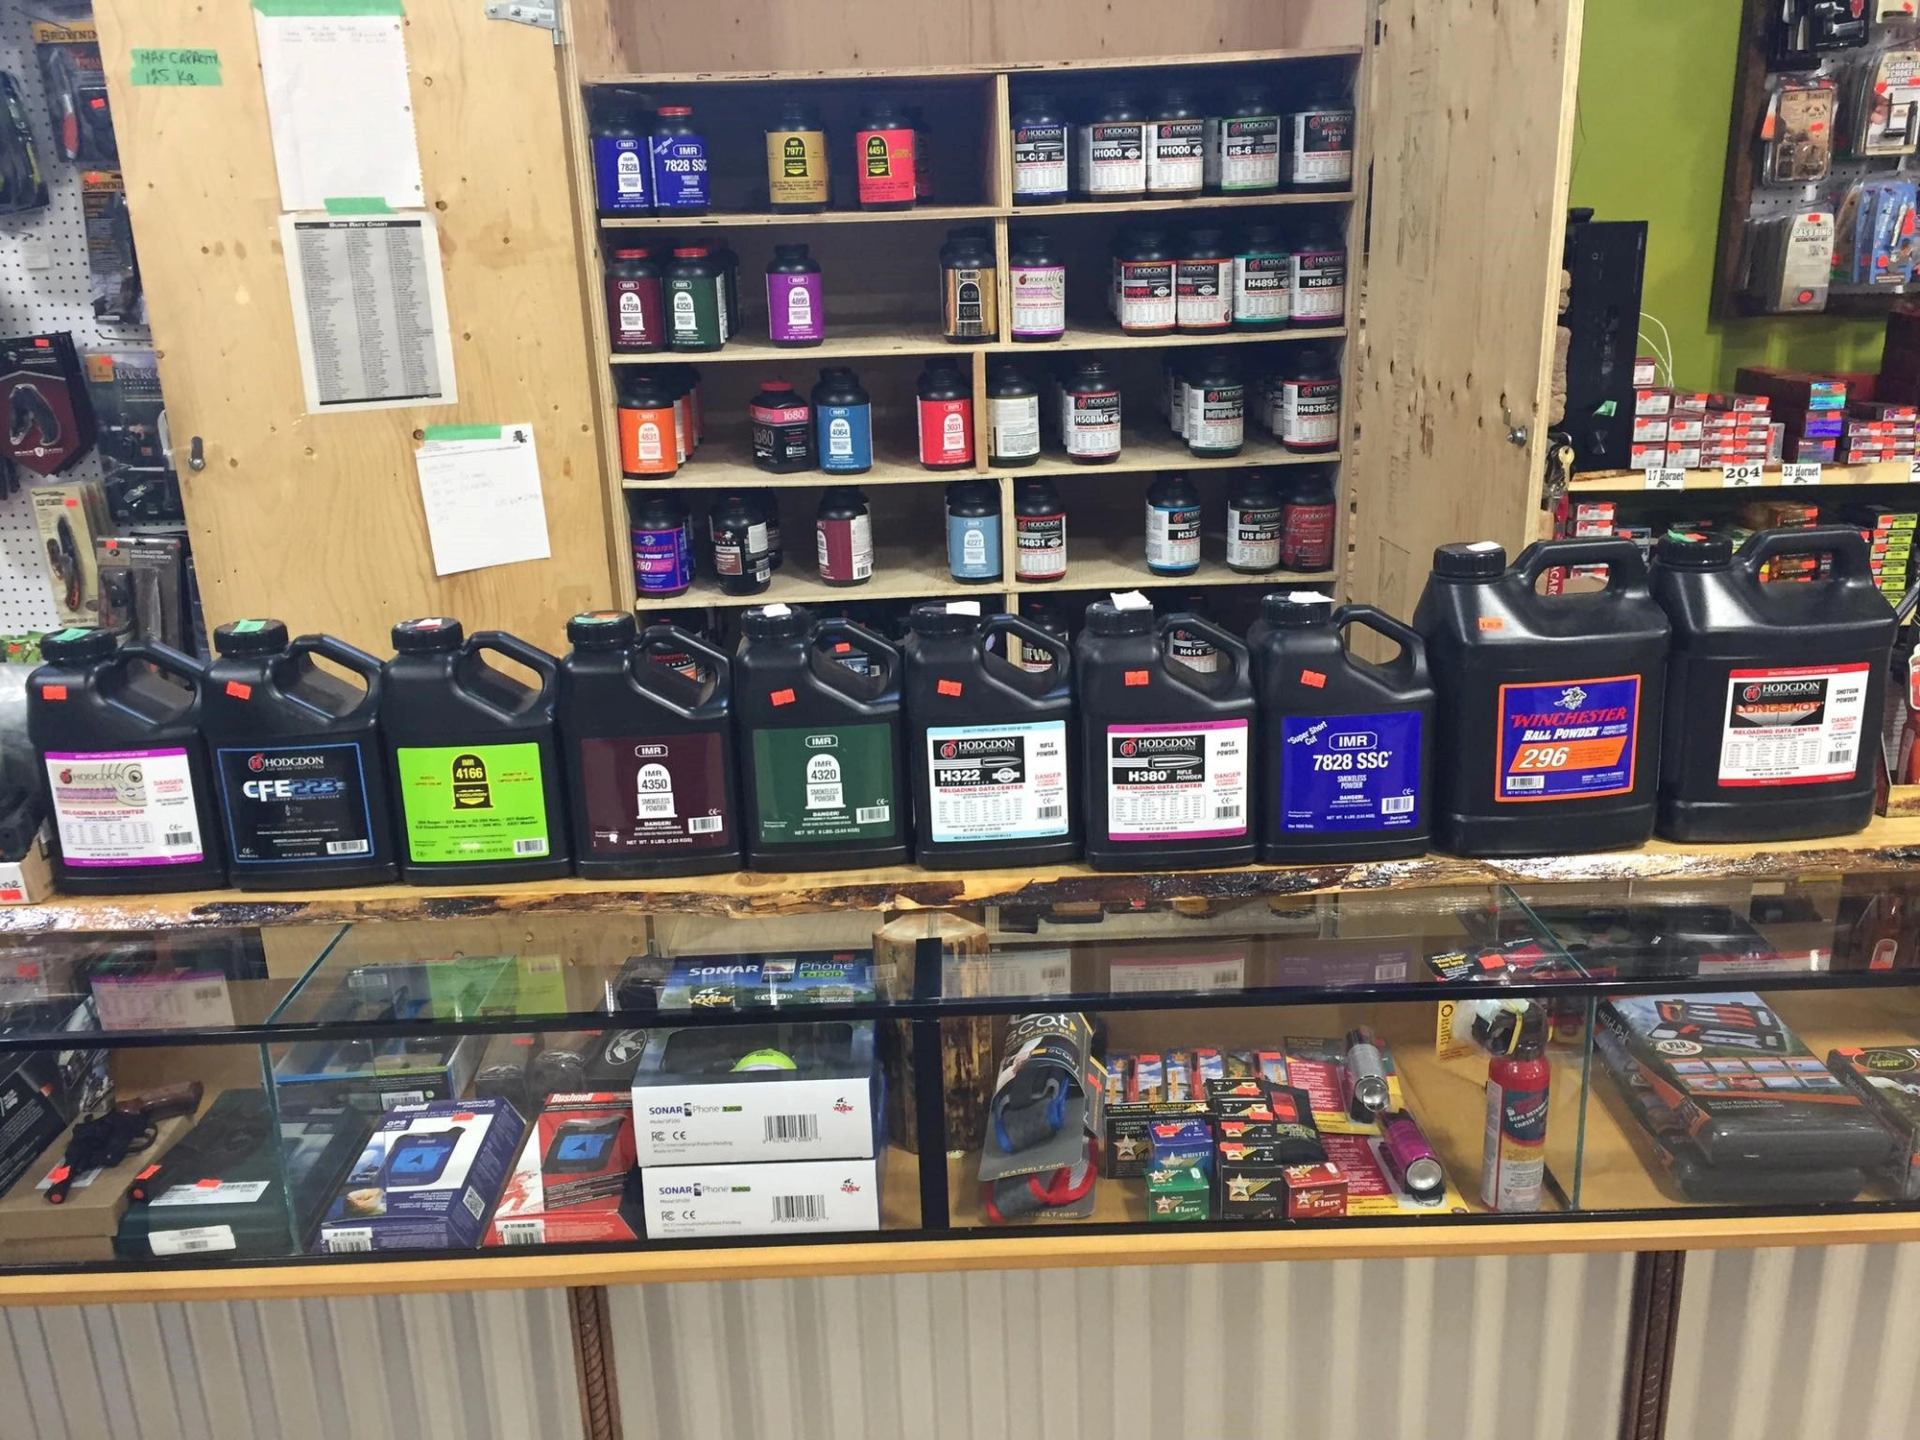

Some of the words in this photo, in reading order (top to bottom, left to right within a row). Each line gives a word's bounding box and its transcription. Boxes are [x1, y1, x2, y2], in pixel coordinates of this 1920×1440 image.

[40, 30, 97, 41] BROWNIN
[679, 146, 697, 155] IMR
[786, 147, 803, 155] 7977
[869, 146, 884, 154] 4451
[1094, 149, 1122, 158] H1000
[1160, 146, 1190, 155] H1000
[1229, 146, 1252, 155] HS-6
[621, 163, 637, 171] 7828
[665, 160, 689, 171] 7828
[1248, 279, 1279, 288] H4895
[1308, 278, 1333, 286] H380
[783, 411, 805, 420] 1680
[1075, 416, 1109, 424] H50BMG
[832, 428, 849, 436] 4064
[1648, 470, 1658, 480] 17
[1659, 469, 1684, 481] Hornet
[1725, 467, 1760, 478] 204
[1784, 467, 1794, 477] 22
[1795, 466, 1819, 477] Hornet
[1180, 648, 1201, 656] H414
[1762, 682, 1820, 692] HODGDON
[1735, 702, 1820, 713] LONGSHOT
[1511, 707, 1627, 727] WINCHESTER
[1309, 721, 1327, 734] Short
[1522, 730, 1551, 741] BALL
[1554, 727, 1599, 739] POWDER
[959, 739, 1016, 749] HODGDON
[1139, 738, 1196, 747] HODGDON
[1305, 736, 1317, 745] Cut
[1338, 735, 1368, 747] IMR
[265, 756, 324, 767] HODGDON
[1313, 754, 1352, 771] 7828
[1357, 751, 1389, 769] SSC
[1519, 747, 1570, 769] 296
[456, 767, 483, 779] 4166
[811, 770, 837, 780] 4320
[940, 769, 980, 781] H322
[1128, 771, 1167, 782] H380
[1214, 771, 1241, 779] DANGER
[641, 779, 667, 789] 4350
[689, 965, 758, 976] SONAR
[800, 962, 854, 970] Phone
[551, 1093, 593, 1102] Bushnell
[649, 1107, 683, 1115] SONAR
[692, 1105, 720, 1113] Phone
[659, 1187, 692, 1195] SONAR
[702, 1185, 729, 1193] Phone
